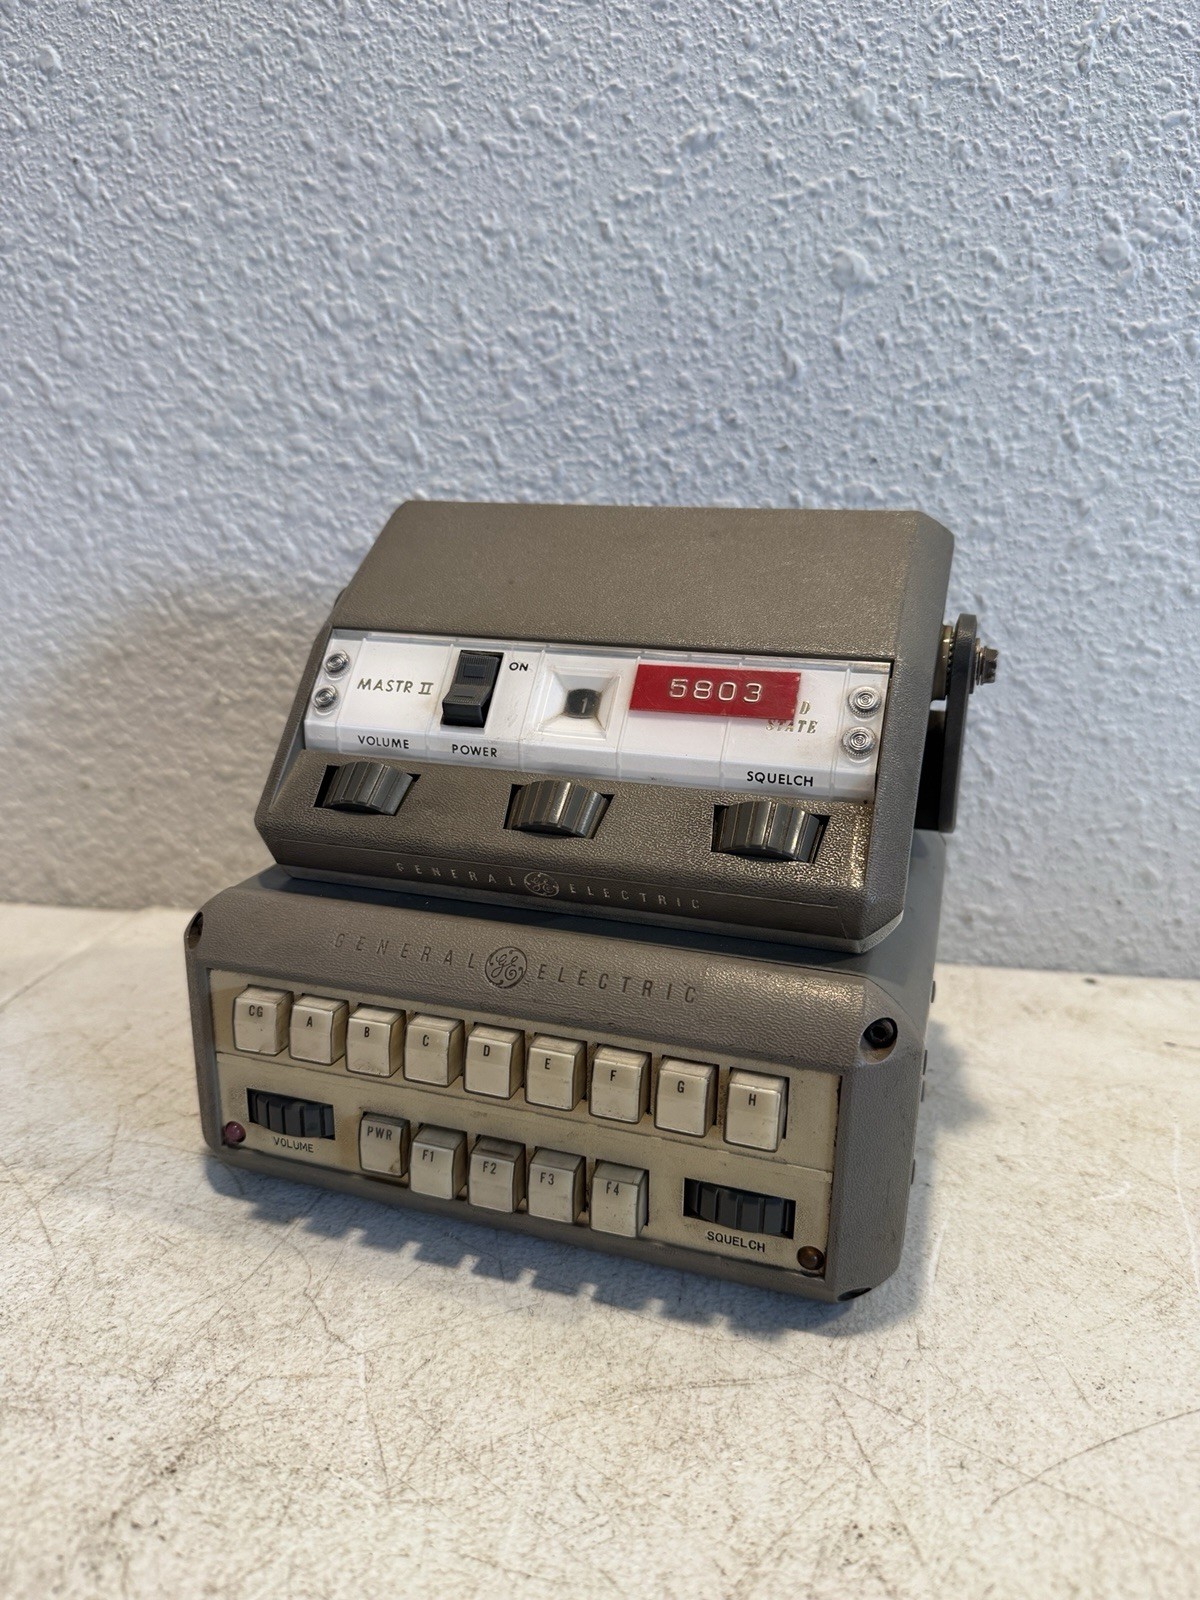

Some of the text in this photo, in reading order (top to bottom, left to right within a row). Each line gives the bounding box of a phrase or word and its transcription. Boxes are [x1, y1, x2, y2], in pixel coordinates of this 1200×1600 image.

[509, 662, 529, 672] ON
[356, 678, 434, 696] MASTR II
[669, 678, 763, 703] 5803
[357, 735, 410, 750] VOLUME
[452, 744, 498, 758] POWER
[746, 770, 814, 788] SQUELCH
[396, 862, 516, 887] GENERAL
[569, 883, 701, 909] ELECTRIC
[334, 932, 475, 970] GENERAL
[537, 963, 696, 1004] ELECTRIC
[248, 1005, 263, 1018] CG
[306, 1016, 313, 1028] A
[364, 1026, 370, 1038] B
[422, 1034, 429, 1047] C
[483, 1045, 491, 1057] D
[544, 1058, 551, 1070] E
[610, 1070, 617, 1082] F
[677, 1081, 685, 1093] G
[748, 1094, 756, 1106] H
[367, 1126, 392, 1141] PWR
[273, 1137, 314, 1153] VOLUME
[422, 1150, 434, 1163] F1
[482, 1161, 497, 1175] F2
[540, 1172, 554, 1186] F3
[606, 1181, 619, 1196] F4
[707, 1231, 765, 1253] SQUELCH
